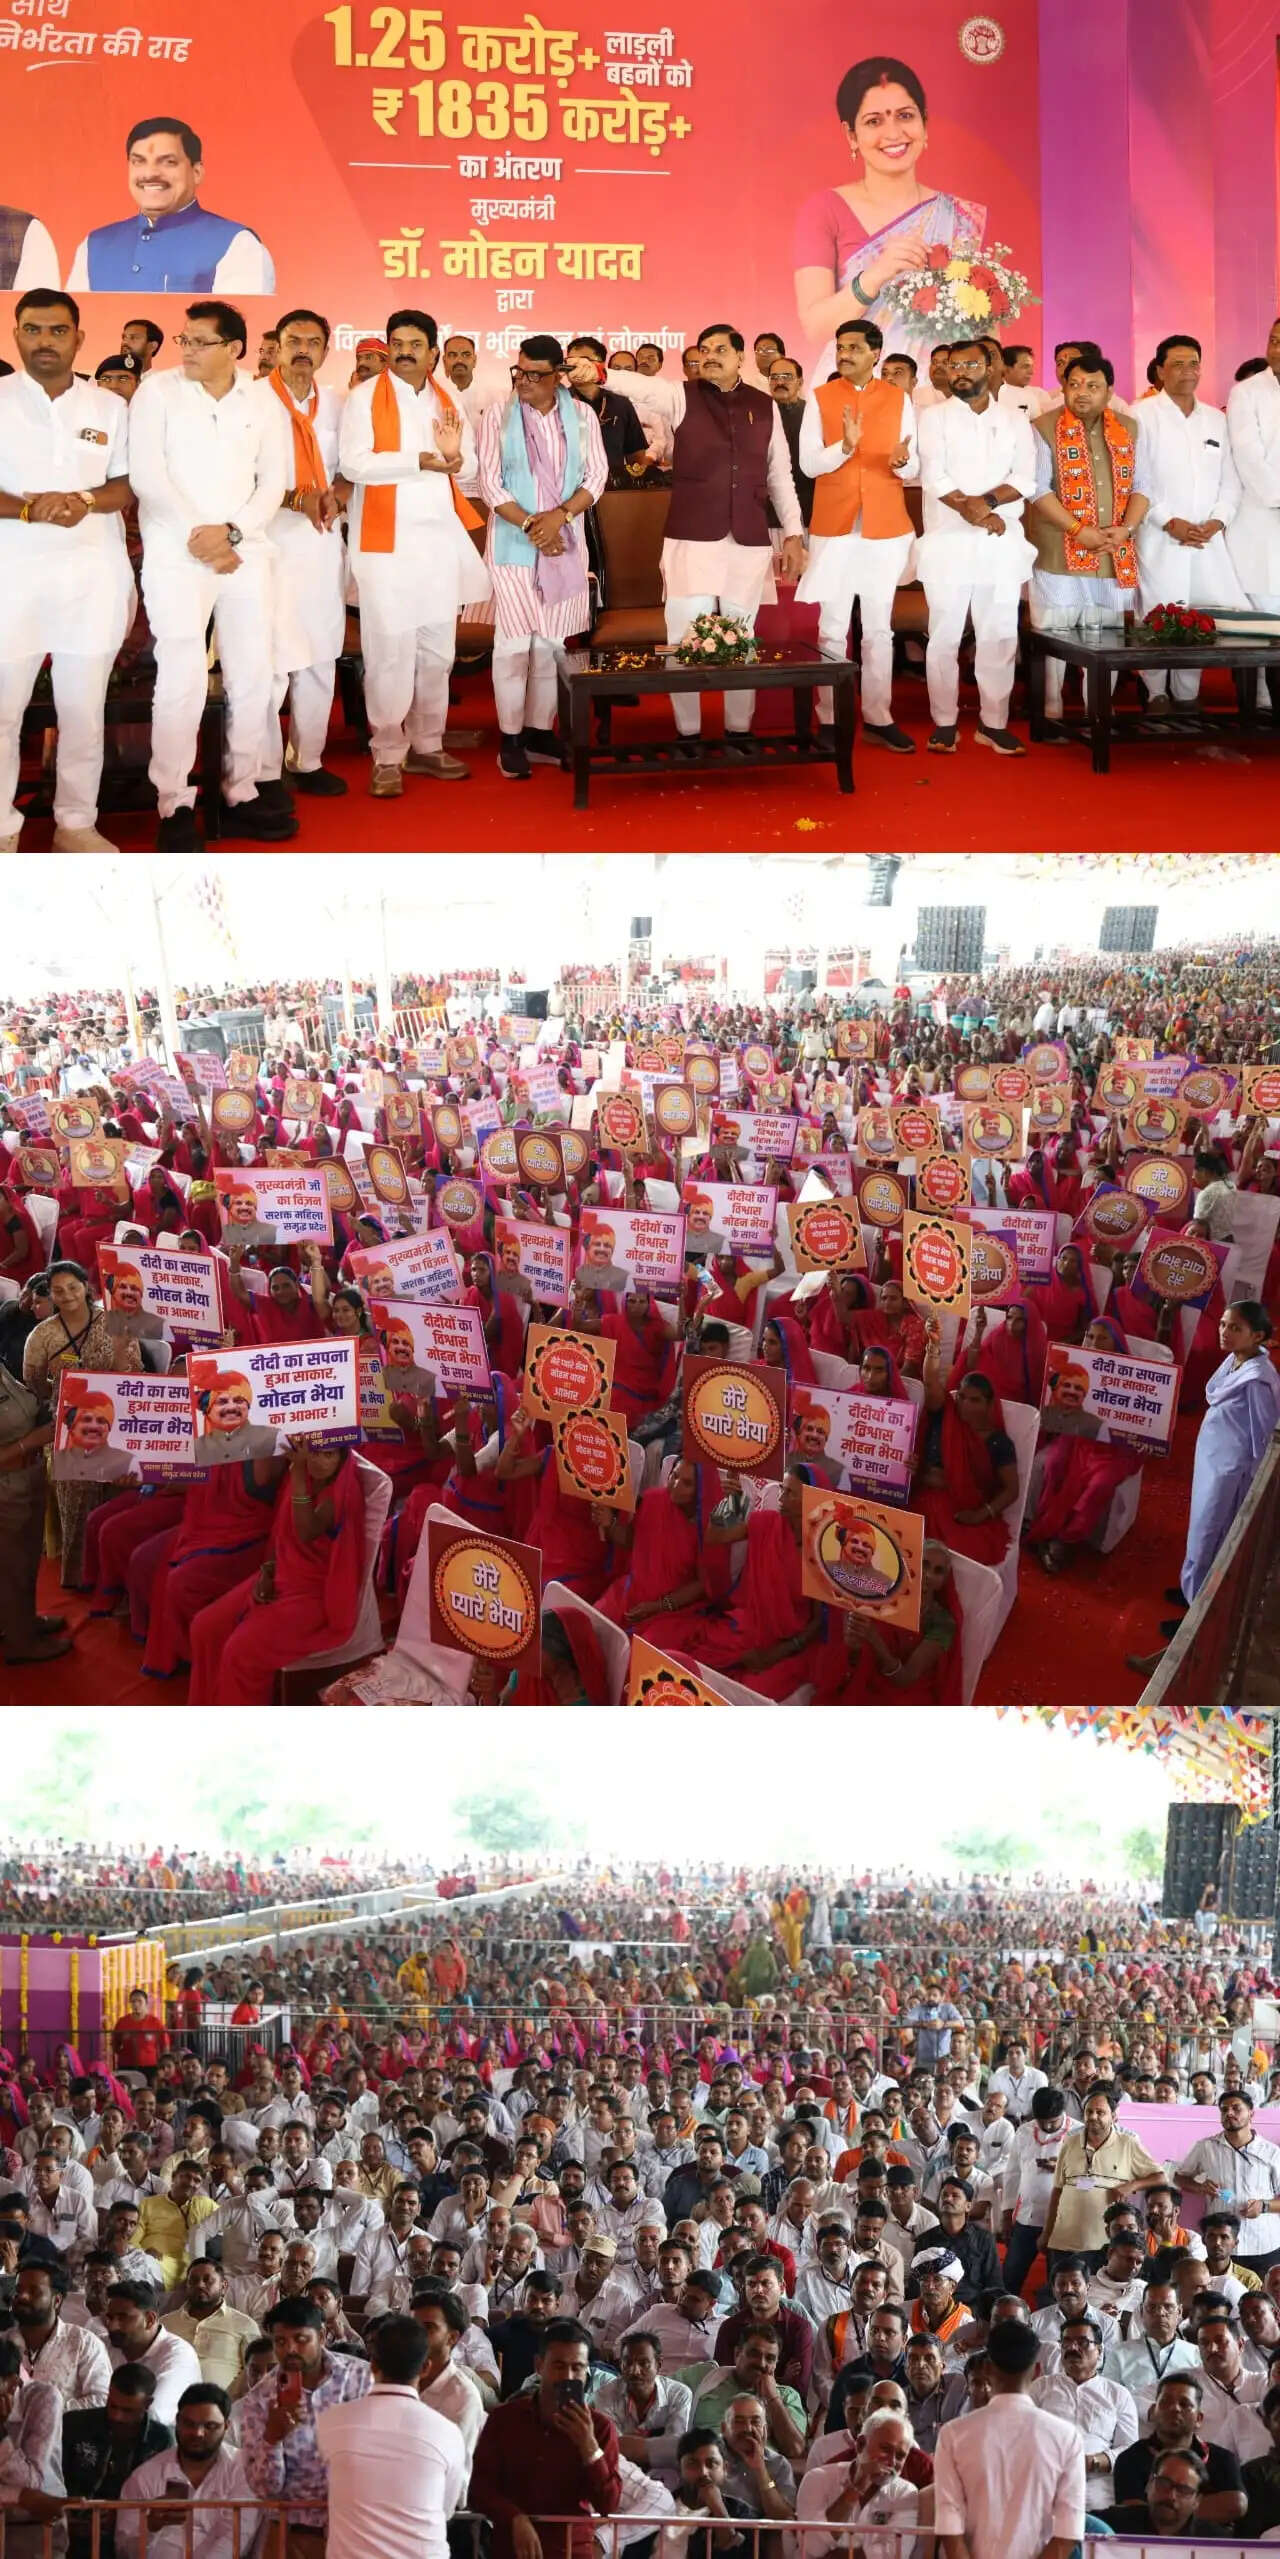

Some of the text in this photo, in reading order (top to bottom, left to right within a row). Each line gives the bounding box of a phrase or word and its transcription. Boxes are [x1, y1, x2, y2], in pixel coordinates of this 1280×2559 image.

[103, 27, 143, 57] की
[148, 36, 193, 63] राह
[324, 5, 600, 89] 1.25 करोड़+
[604, 28, 674, 60] लाड़ली
[605, 58, 693, 88] बहनों को
[559, 87, 692, 156] करोड़+
[457, 151, 564, 181] का अंतरण
[469, 194, 556, 225] मुख्यमंत्री
[379, 227, 645, 281] डॉ. मोहन यादव
[496, 289, 534, 312] द्वारा
[255, 1178, 306, 1194] मुख्यमंत्री
[308, 1180, 321, 1191] जी
[276, 1196, 290, 1206] का
[757, 1194, 768, 1204] का
[294, 1208, 323, 1221] महिला
[663, 1224, 676, 1235] का
[1034, 1221, 1048, 1230] का
[433, 1239, 445, 1251] जी
[625, 1247, 653, 1261] मोहन
[139, 1253, 211, 1276] दीदी का सपना
[408, 1263, 421, 1274] का
[646, 1266, 666, 1276] साथ
[151, 1271, 170, 1285] हुआ
[147, 1284, 210, 1307] मोहन भैया
[156, 1305, 200, 1320] का आभार
[457, 1318, 472, 1332] का
[432, 1330, 468, 1349] विश्वास
[249, 1349, 349, 1371] दीदी का सपना
[425, 1346, 482, 1366] मोहन भैया
[264, 1367, 337, 1388] हुआ साकार,
[440, 1363, 473, 1380] के साथ
[1092, 1357, 1171, 1385] दीदी का सपना
[1100, 1374, 1121, 1388] हुआ
[116, 1380, 144, 1397] दीदी
[147, 1385, 165, 1398] का
[257, 1383, 345, 1408] मोहन भैया
[721, 1384, 748, 1411] मेरे
[128, 1400, 151, 1414] हुआ
[1092, 1388, 1163, 1415] मोहन भैया
[268, 1412, 286, 1425] का
[289, 1407, 329, 1422] आभार
[848, 1402, 904, 1427] दीदीयों का
[1097, 1406, 1146, 1426] का आभार
[118, 1415, 164, 1435] मोहन
[701, 1412, 769, 1444] प्यारे भैया
[126, 1439, 182, 1451] का आभार
[841, 1437, 904, 1462] मोहन भैया
[852, 1455, 890, 1475] के साथ
[472, 1560, 501, 1593] मेरे
[450, 1591, 524, 1634] प्यारे भैया
